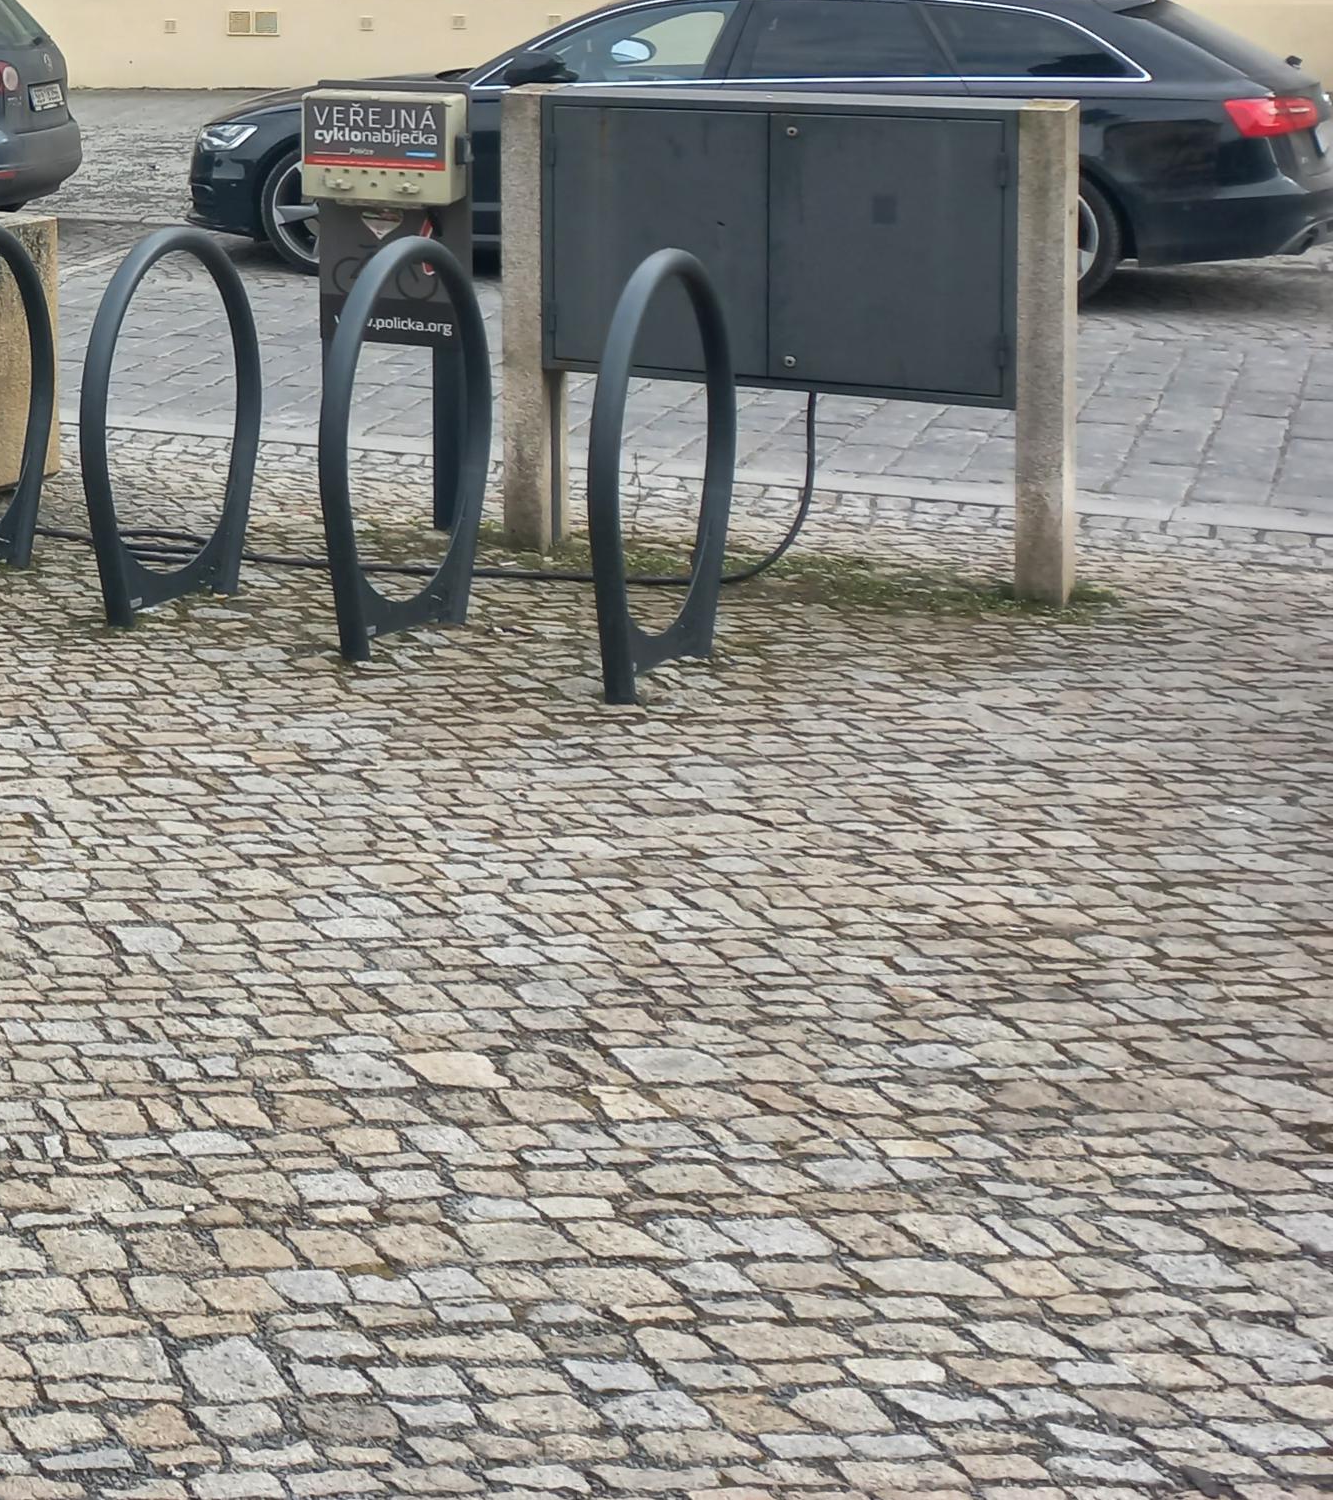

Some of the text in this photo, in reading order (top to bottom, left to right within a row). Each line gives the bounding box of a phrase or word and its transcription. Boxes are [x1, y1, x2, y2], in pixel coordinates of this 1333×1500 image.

[313, 103, 437, 130] VEŘEJNÁ
[313, 126, 438, 147] cyklonabíječka
[334, 315, 453, 336] .policka.org
